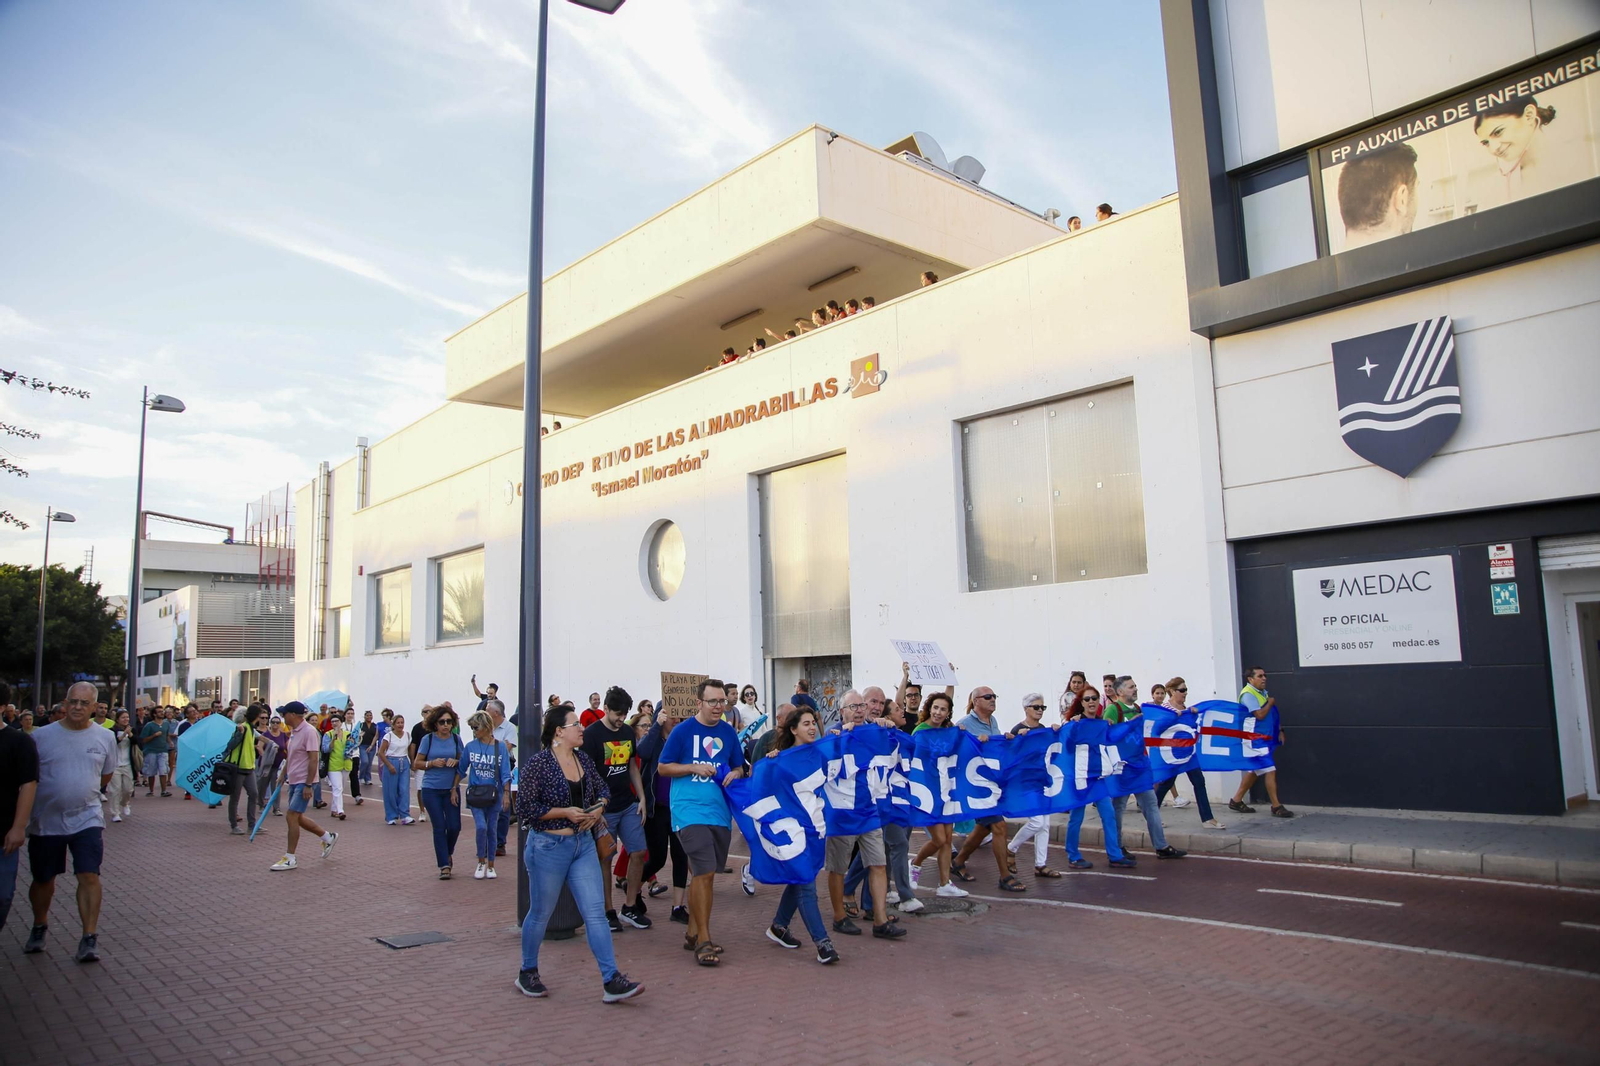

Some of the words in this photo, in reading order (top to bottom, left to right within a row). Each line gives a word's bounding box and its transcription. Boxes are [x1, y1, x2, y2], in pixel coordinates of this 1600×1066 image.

[1331, 146, 1351, 163] FP
[1356, 115, 1438, 155] AUXILIAR
[1443, 103, 1470, 124] DE
[634, 438, 653, 459] DE
[656, 427, 685, 452] LAS
[688, 377, 839, 442] ALMADRABILLAS
[1339, 570, 1432, 598] MEDAC
[1323, 616, 1337, 626] FP
[1340, 613, 1389, 625] OFICIAL
[1323, 626, 1373, 636] PRESENCIAL
[1375, 625, 1381, 633] Y
[1382, 623, 1413, 632] ONLINE
[1324, 643, 1339, 651] 950
[1341, 642, 1356, 650] 805
[1358, 641, 1374, 649] 057
[1392, 638, 1440, 648] medac.es
[917, 655, 930, 664] NO
[911, 665, 923, 679] SE
[662, 675, 668, 683] LA
[669, 674, 688, 684] PLAYA
[689, 676, 696, 684] DE
[664, 696, 676, 706] NO
[678, 697, 685, 706] LA
[671, 708, 679, 716] EN
[693, 735, 700, 758] I
[475, 769, 495, 778] PARIS
